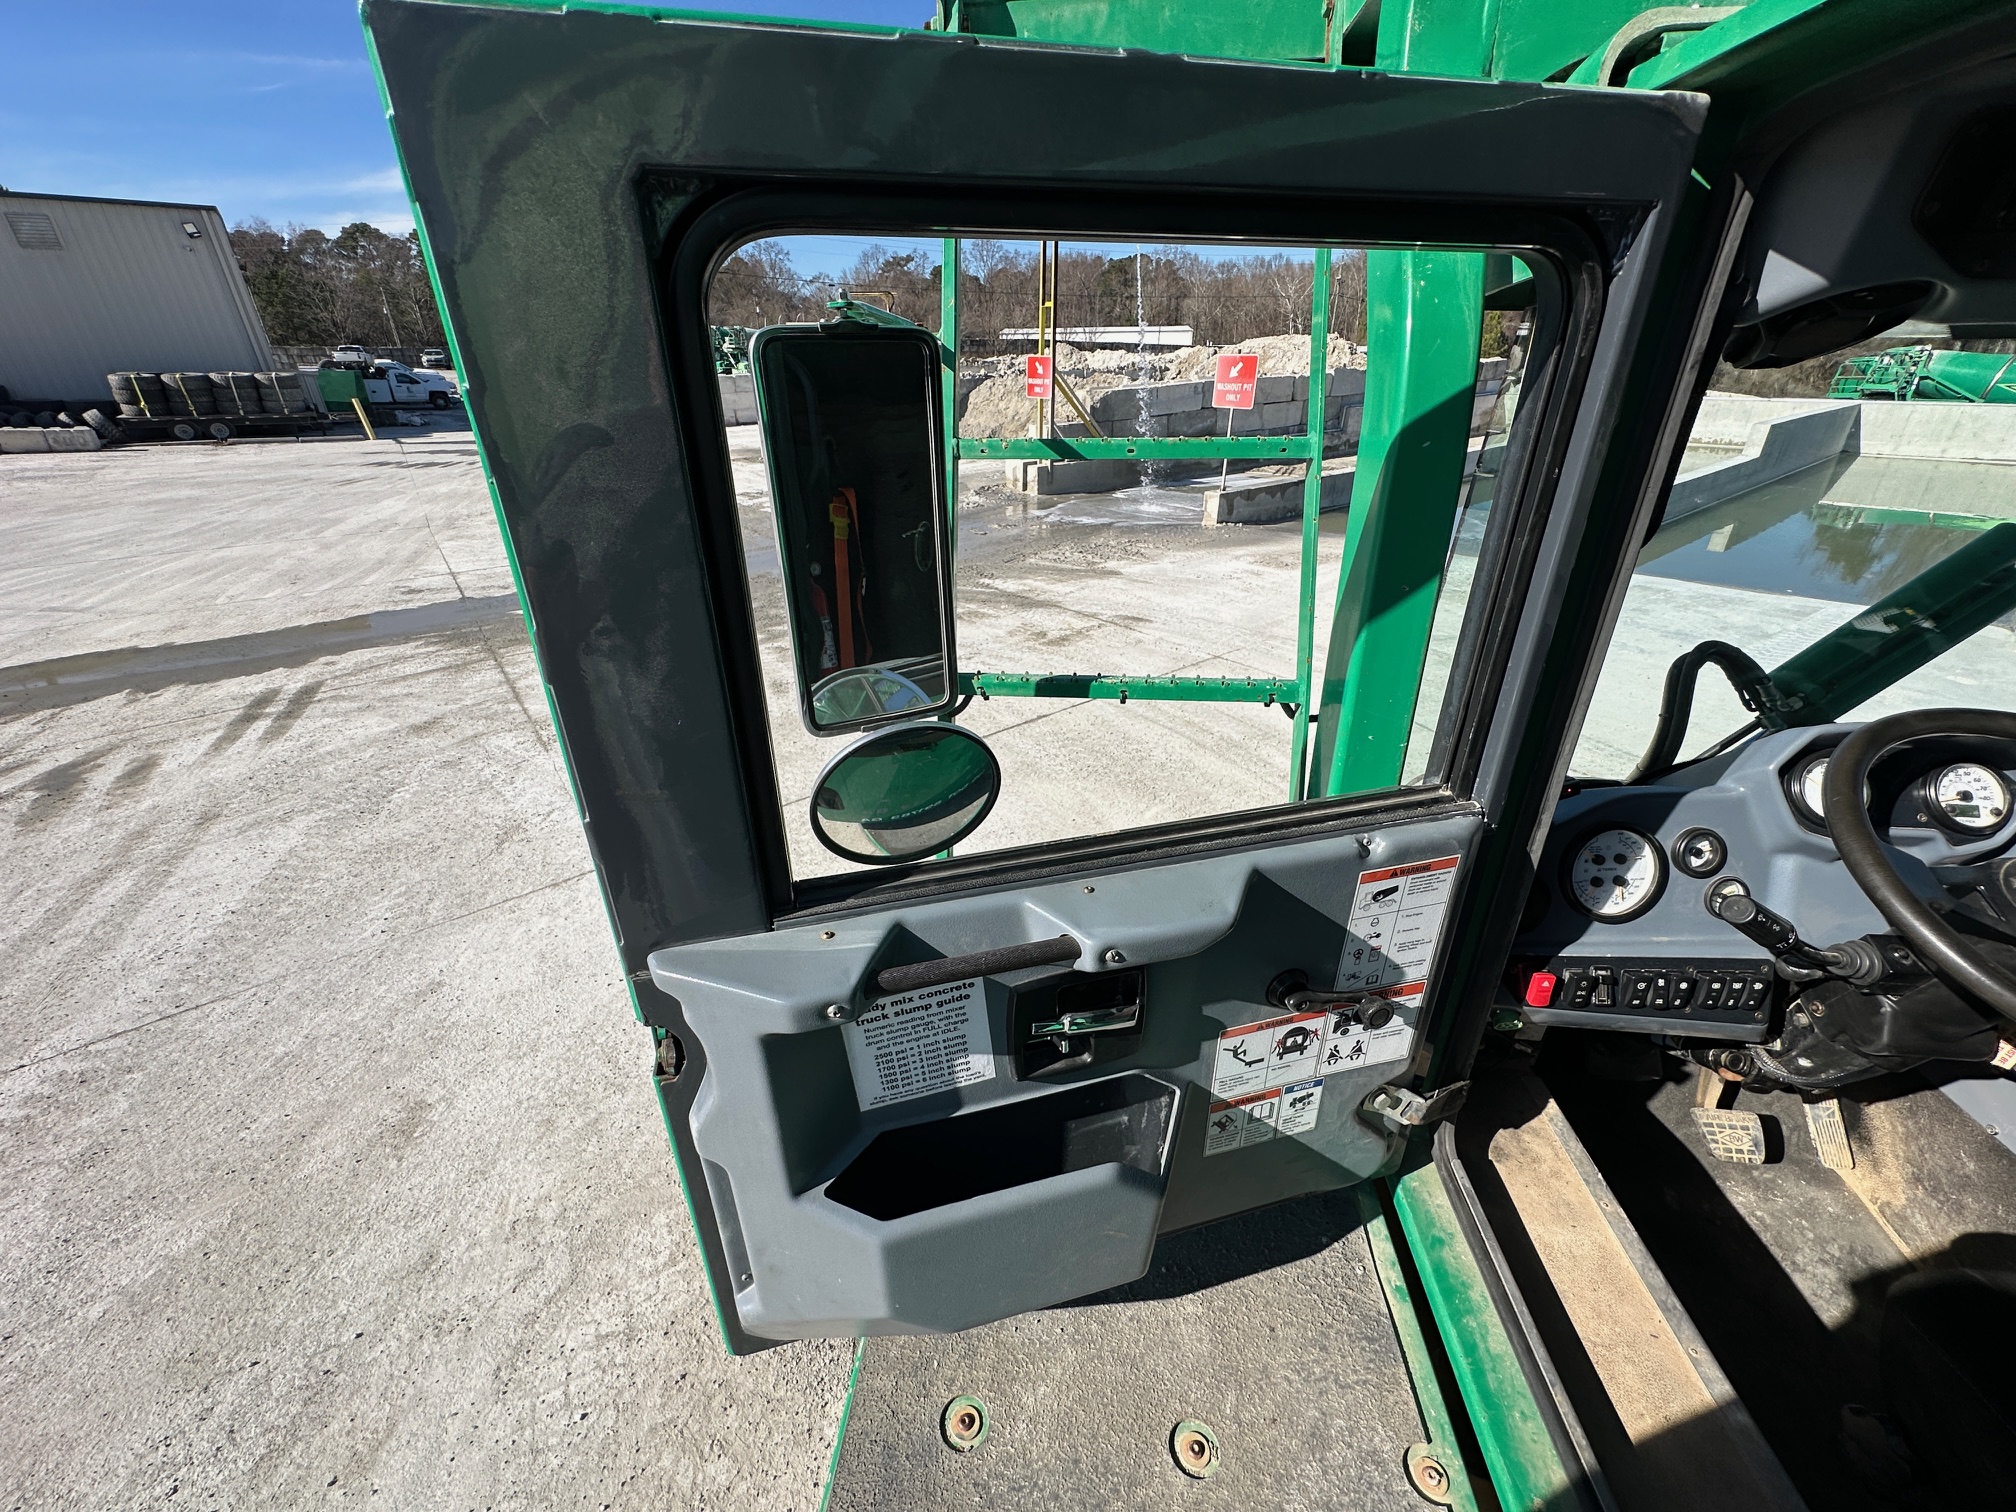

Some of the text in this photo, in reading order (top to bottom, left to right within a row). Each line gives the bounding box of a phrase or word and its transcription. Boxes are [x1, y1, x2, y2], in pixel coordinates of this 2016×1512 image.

[1217, 382, 1253, 391] WASHOUT PIT
[1225, 393, 1241, 402] ONLY
[1400, 864, 1432, 876] WARNING
[890, 996, 914, 1007] mix
[918, 982, 975, 1000] concrete
[1379, 988, 1404, 999] RNING
[854, 993, 971, 1027] truck slump guide
[864, 1023, 895, 1034] Numeric
[897, 1016, 925, 1026] reading
[945, 1005, 966, 1014] mixer
[865, 1032, 884, 1040] truck
[886, 1026, 909, 1035] slump
[911, 1020, 936, 1030] gauge,
[866, 1039, 885, 1047] drum
[886, 1031, 912, 1041] control
[923, 1024, 942, 1033] FULL
[944, 1018, 969, 1027] charge
[906, 1034, 930, 1043] engine
[941, 1026, 960, 1035] IDLE.
[1265, 1018, 1294, 1029] WARNING
[874, 1051, 893, 1060] 2500
[895, 1048, 907, 1056] psi
[923, 1040, 940, 1048] inch
[942, 1034, 966, 1043] slump
[876, 1058, 894, 1067] 2100
[896, 1054, 908, 1063] psi
[924, 1047, 941, 1055] inch
[943, 1041, 967, 1050] slump
[877, 1064, 896, 1073] 1700
[898, 1061, 910, 1069] psi
[925, 1053, 942, 1062] inch
[945, 1046, 969, 1057] slump
[879, 1071, 897, 1079] 1500
[899, 1067, 911, 1076] psi
[927, 1060, 943, 1068] inch
[946, 1052, 969, 1063] slump
[880, 1077, 899, 1086] 1300
[900, 1074, 912, 1082] psi
[928, 1066, 945, 1074] inch
[947, 1061, 970, 1070] slump
[882, 1084, 900, 1092] 1100
[902, 1080, 913, 1088] psi
[929, 1073, 946, 1081] inch
[948, 1067, 971, 1076] slump
[1293, 1081, 1315, 1092] NOTICE
[1235, 1093, 1267, 1105] WARNING
